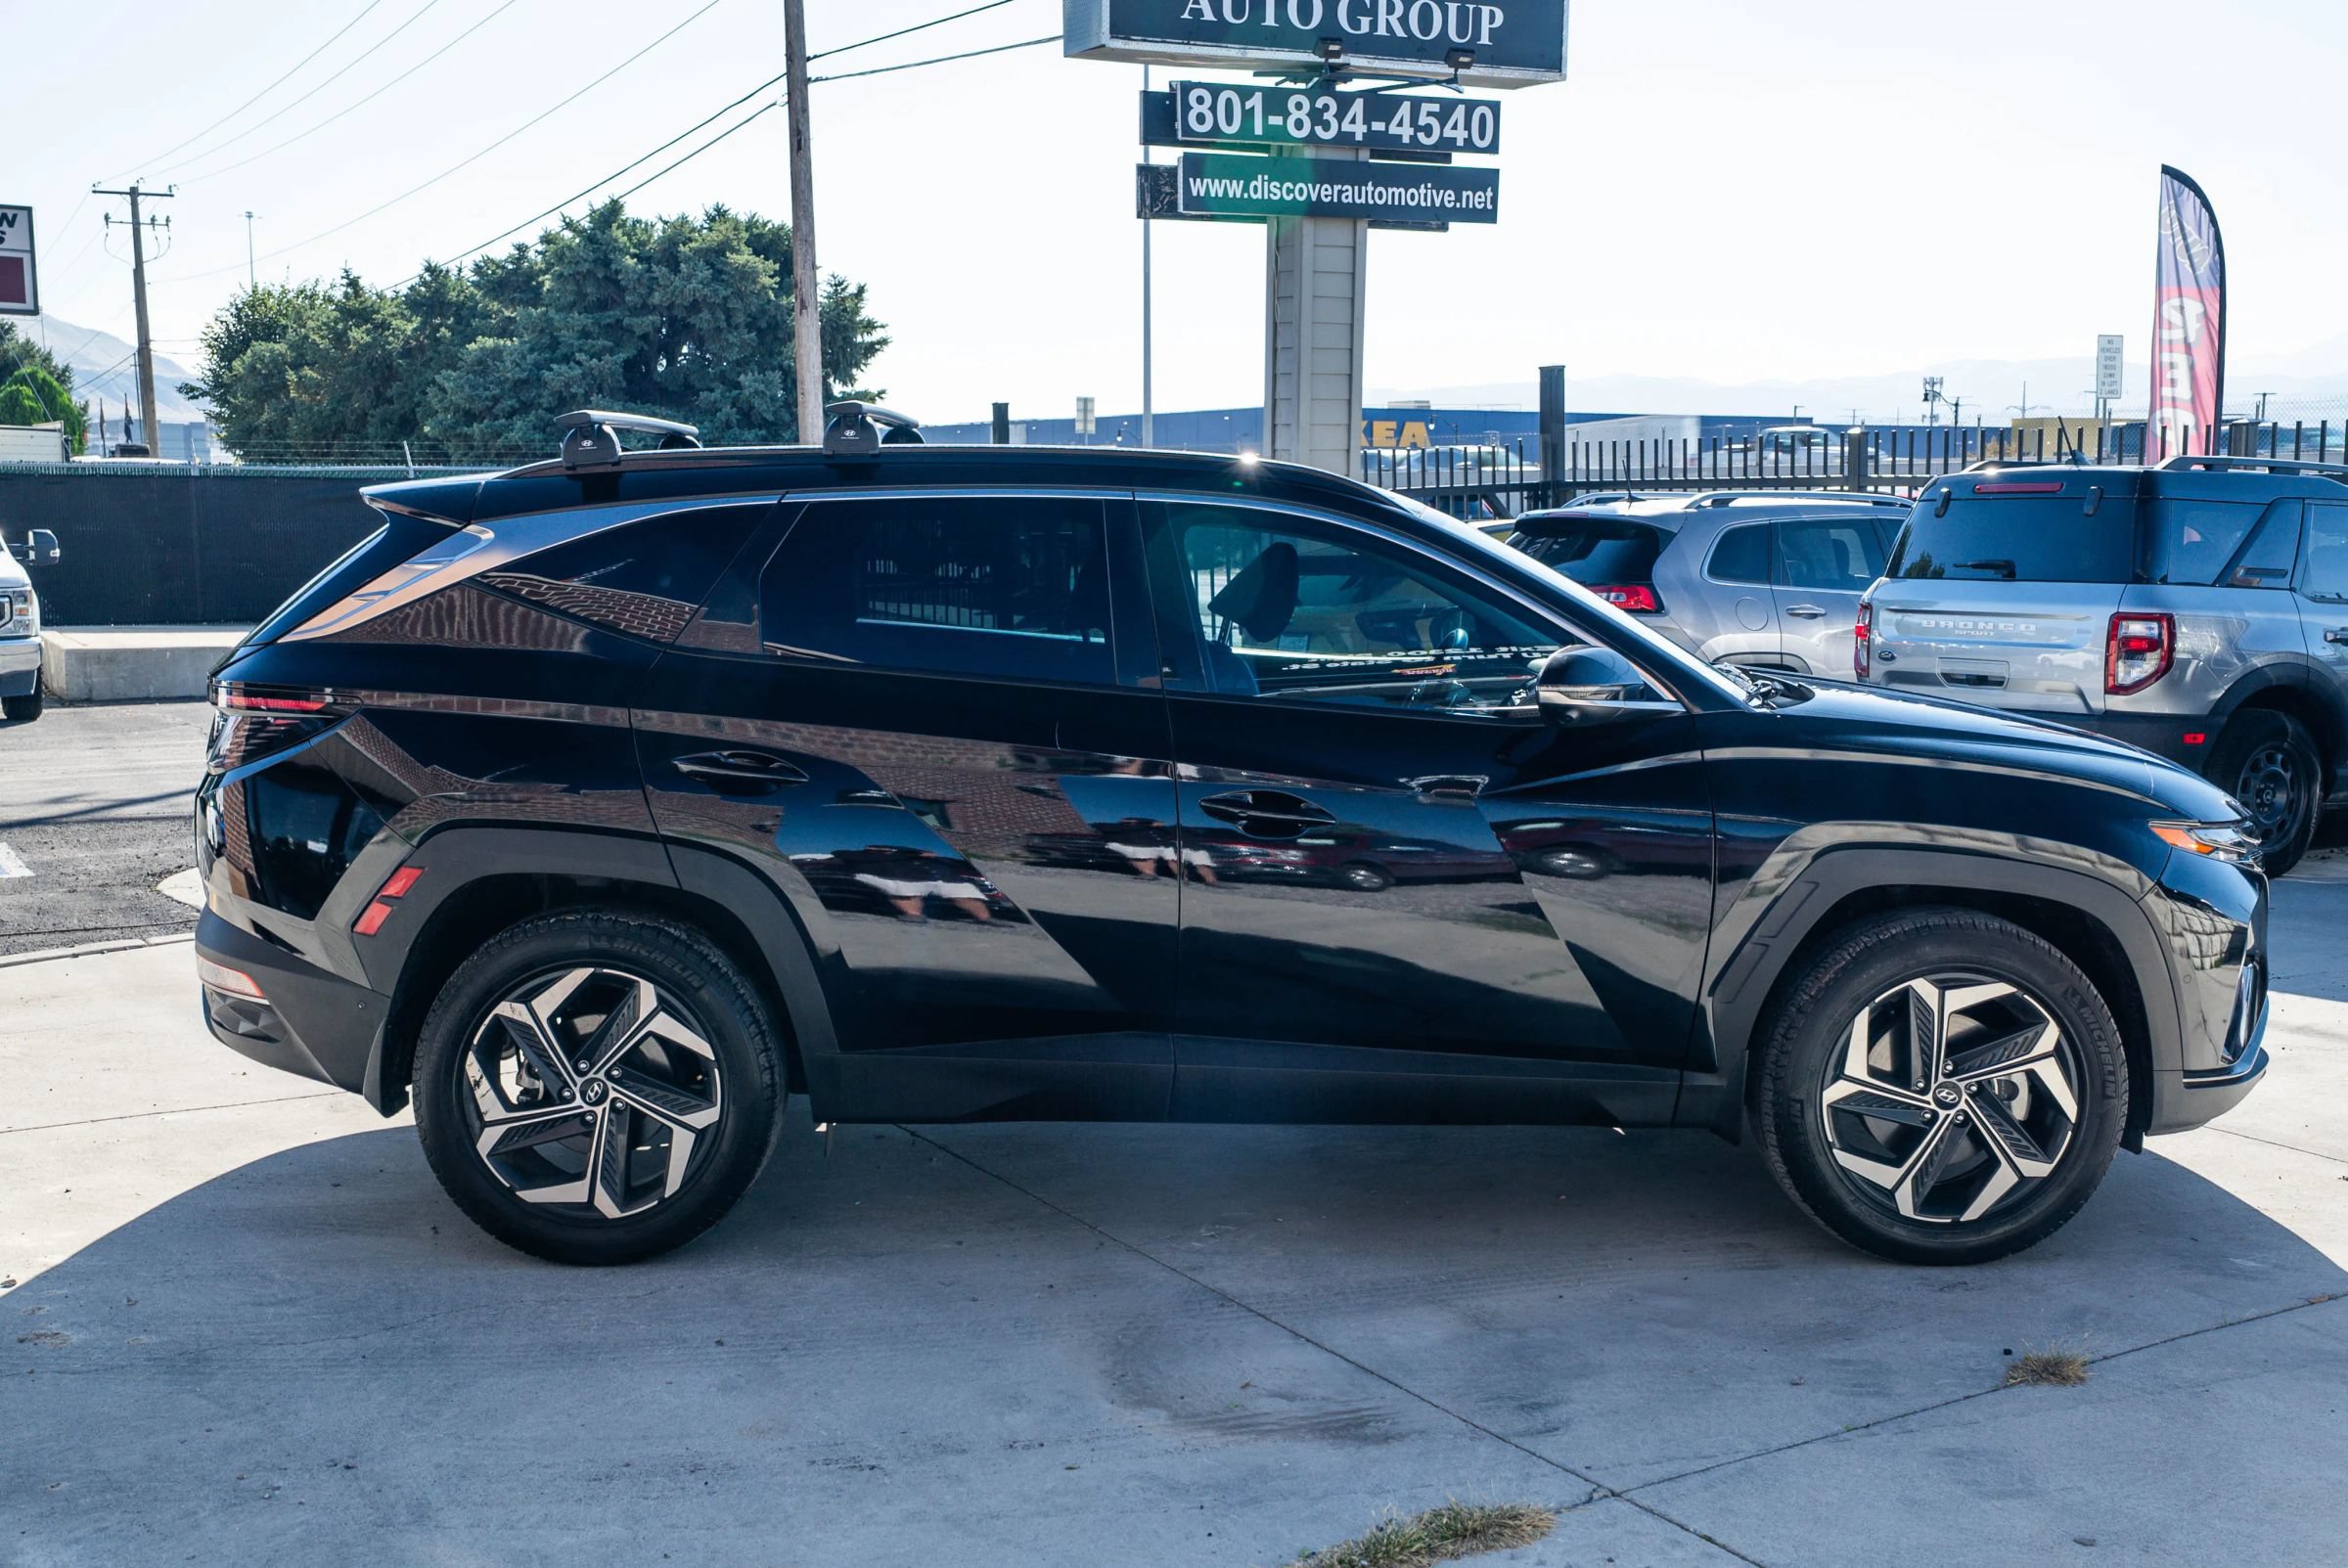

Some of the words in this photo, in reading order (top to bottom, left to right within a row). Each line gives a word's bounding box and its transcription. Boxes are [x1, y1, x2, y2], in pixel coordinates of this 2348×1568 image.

[1336, 0, 1504, 45] GROUP
[1187, 87, 1495, 149] 801-834-4540
[1188, 173, 1494, 210] www.discoverautomotive.net
[1921, 619, 2037, 632] BRONCO
[612, 937, 705, 989] MICHELIN
[2078, 1007, 2117, 1099] MICHELIN
